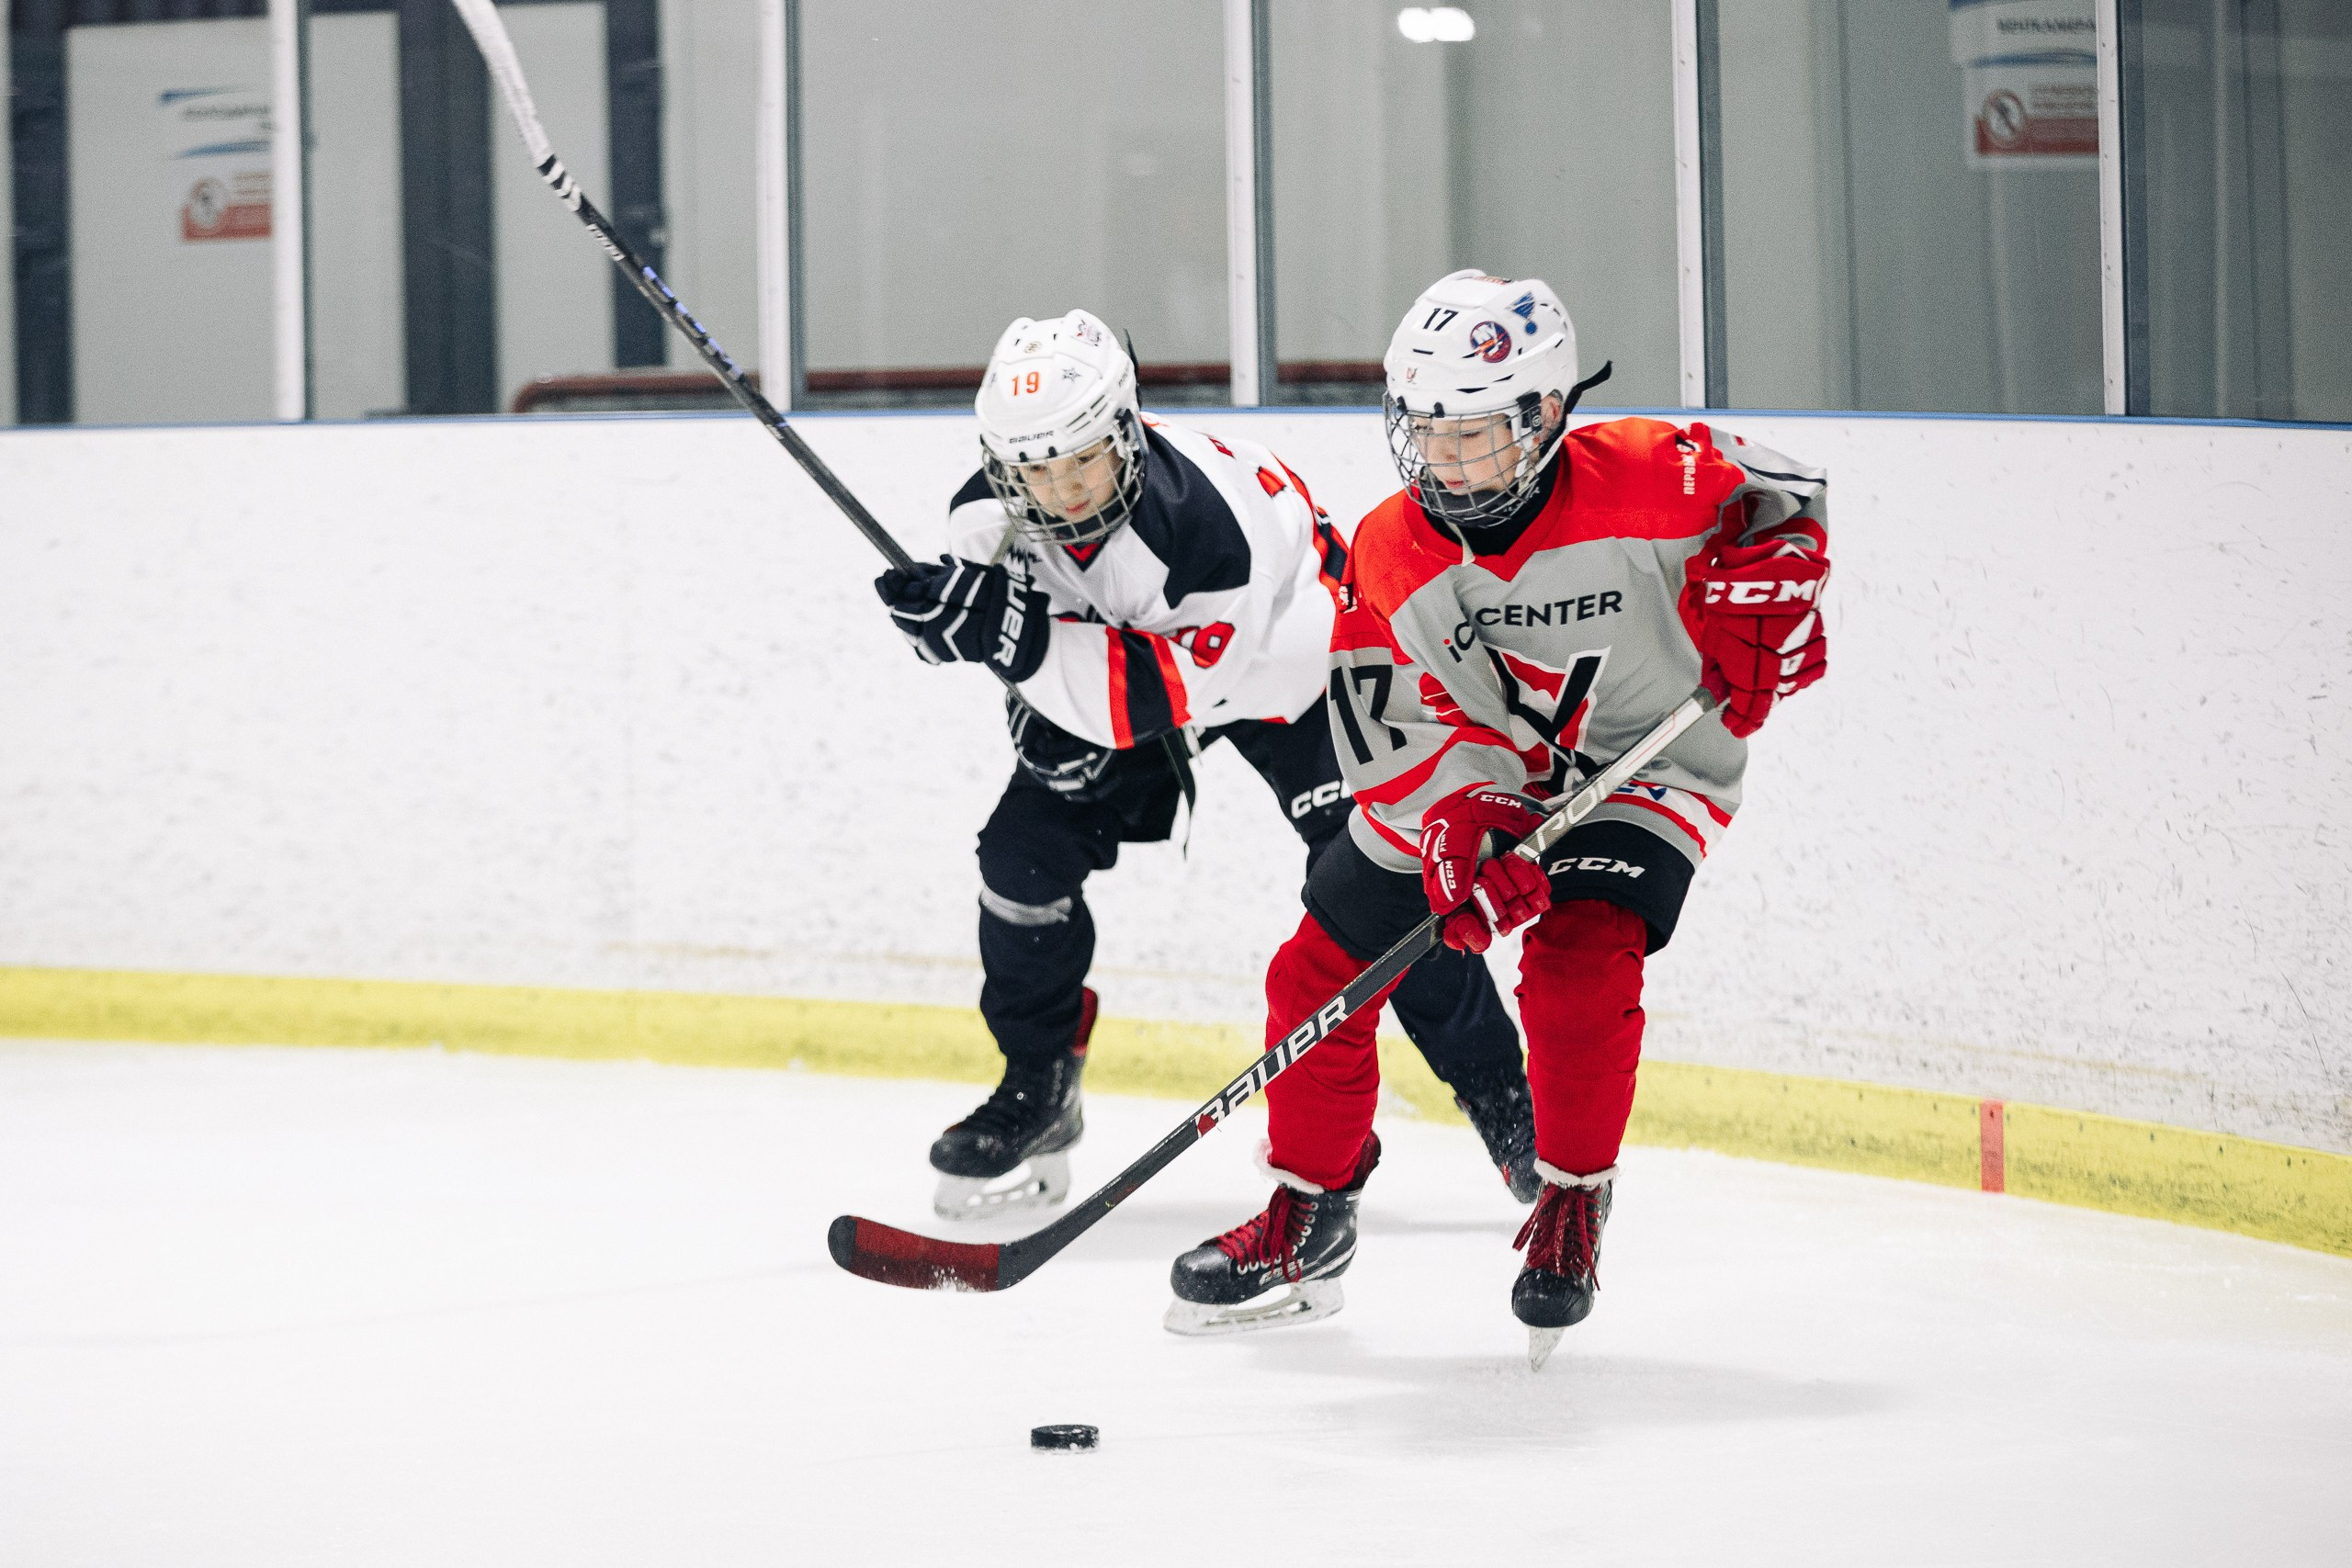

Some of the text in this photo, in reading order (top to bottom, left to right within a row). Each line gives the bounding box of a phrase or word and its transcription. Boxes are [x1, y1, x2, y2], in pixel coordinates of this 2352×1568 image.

[1423, 307, 1459, 332] 17
[1012, 371, 1040, 397] 19
[1705, 579, 1818, 604] CCM
[992, 557, 1028, 668] UER
[1329, 663, 1408, 766] 17
[1291, 779, 1352, 819] CC
[1480, 794, 1522, 809] CCM
[1444, 860, 1457, 890] CCM
[1547, 856, 1645, 879] CCM
[1194, 995, 1350, 1138] BAUER
